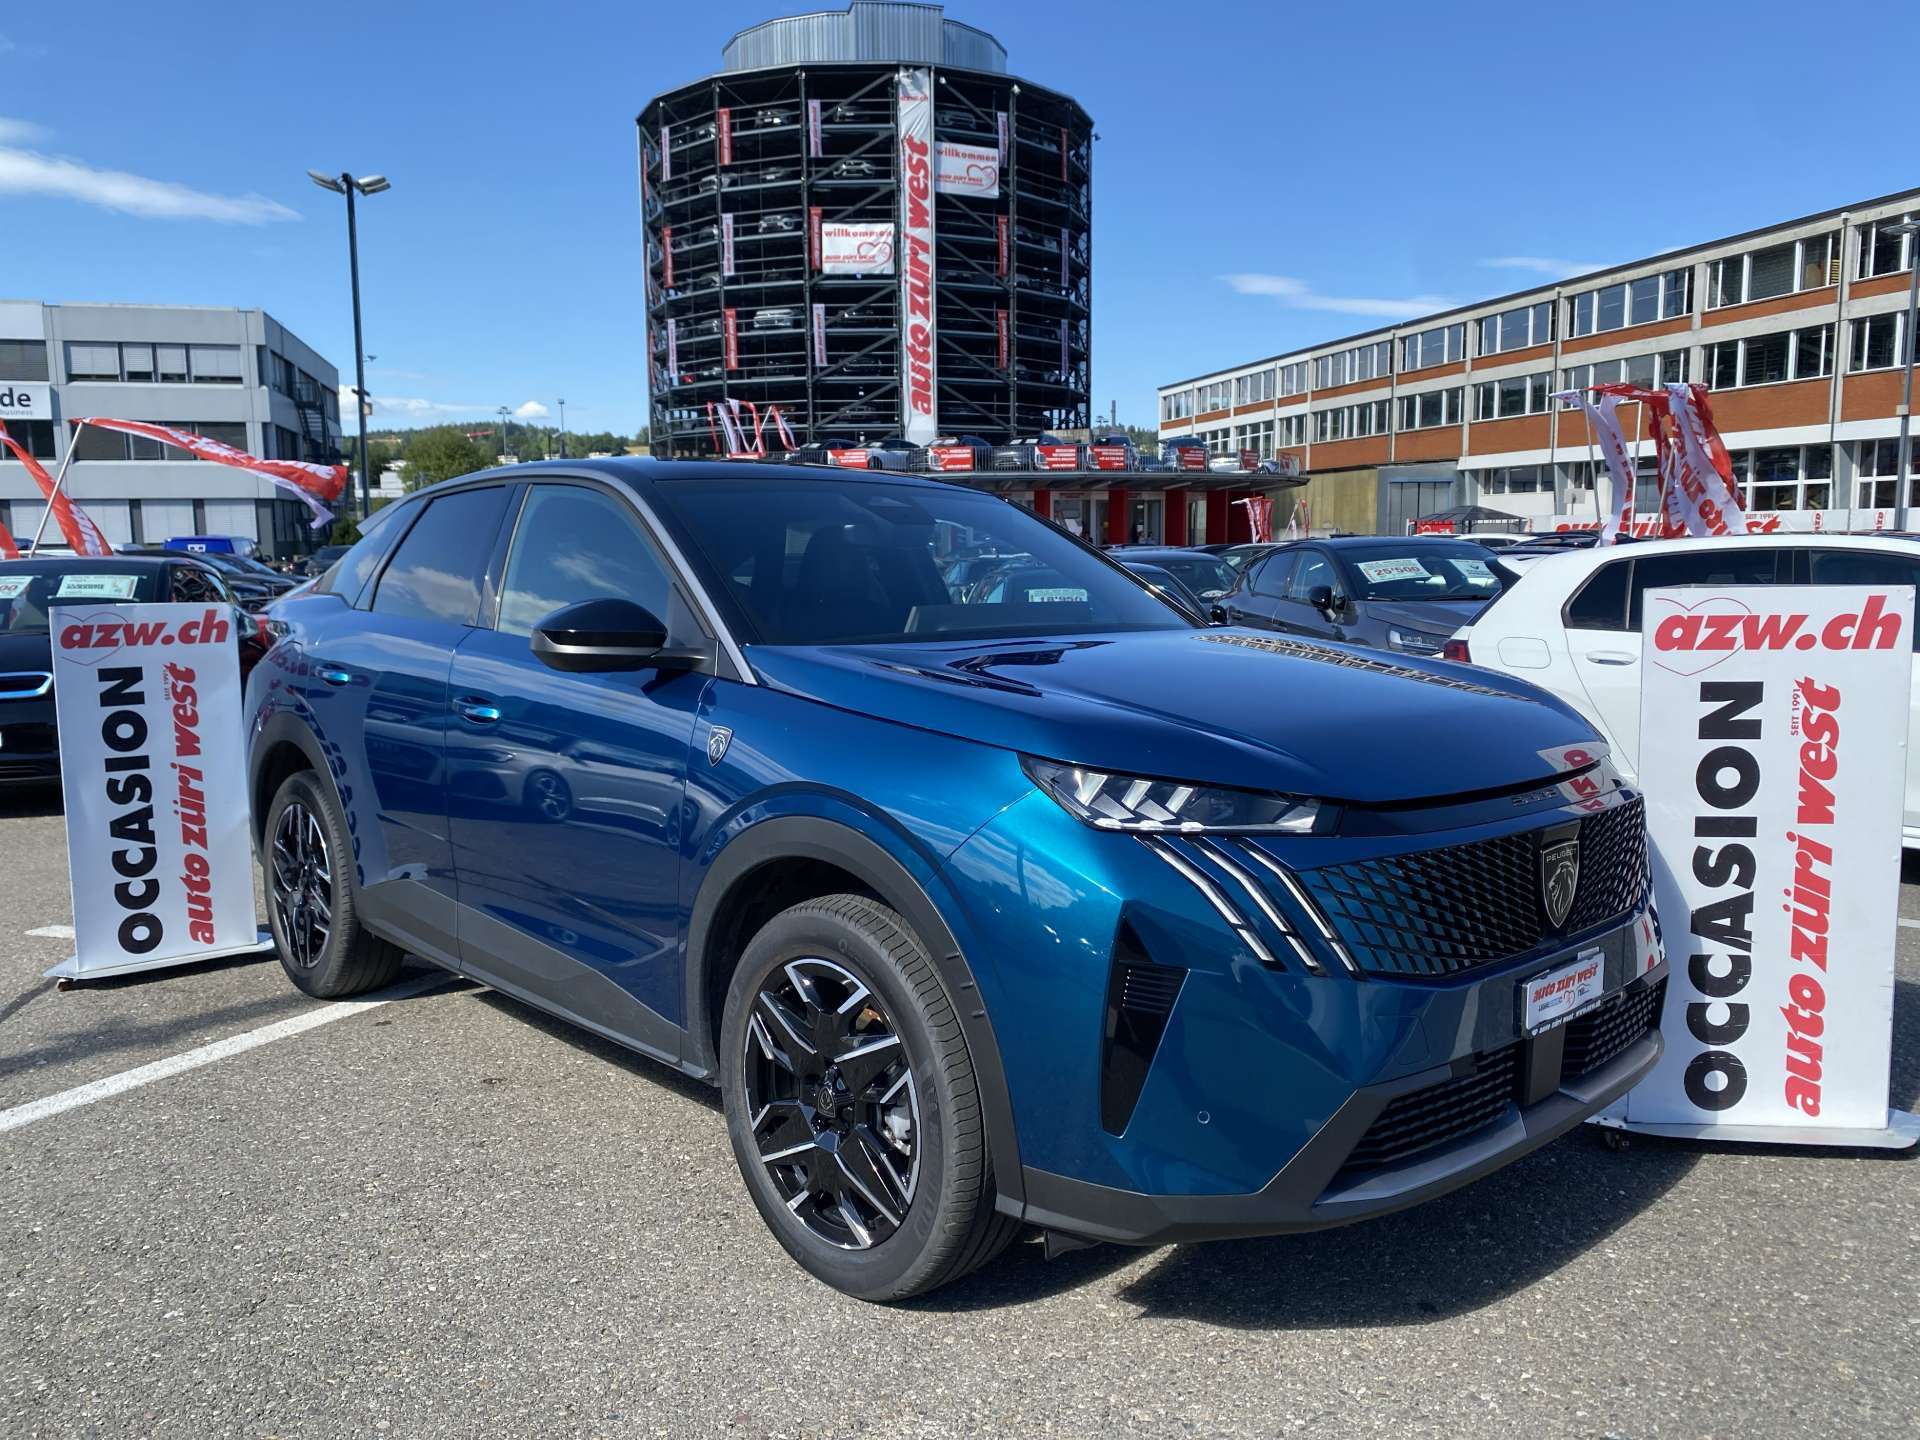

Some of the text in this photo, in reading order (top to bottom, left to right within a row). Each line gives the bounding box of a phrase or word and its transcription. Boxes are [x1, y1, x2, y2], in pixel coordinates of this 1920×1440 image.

[904, 134, 930, 228] west
[936, 148, 997, 161] willkommen
[906, 323, 932, 416] auto
[1375, 566, 1421, 576] 25'500
[60, 609, 229, 649] azw.ch
[1654, 595, 1902, 651] azw.ch
[1790, 688, 1801, 737] SEIT 1991
[97, 666, 163, 954] OCCASION
[162, 662, 215, 945] auto züri west
[1683, 681, 1764, 1112] OCCASION
[1779, 676, 1841, 1118] auto züri west
[1577, 962, 1599, 984] west
